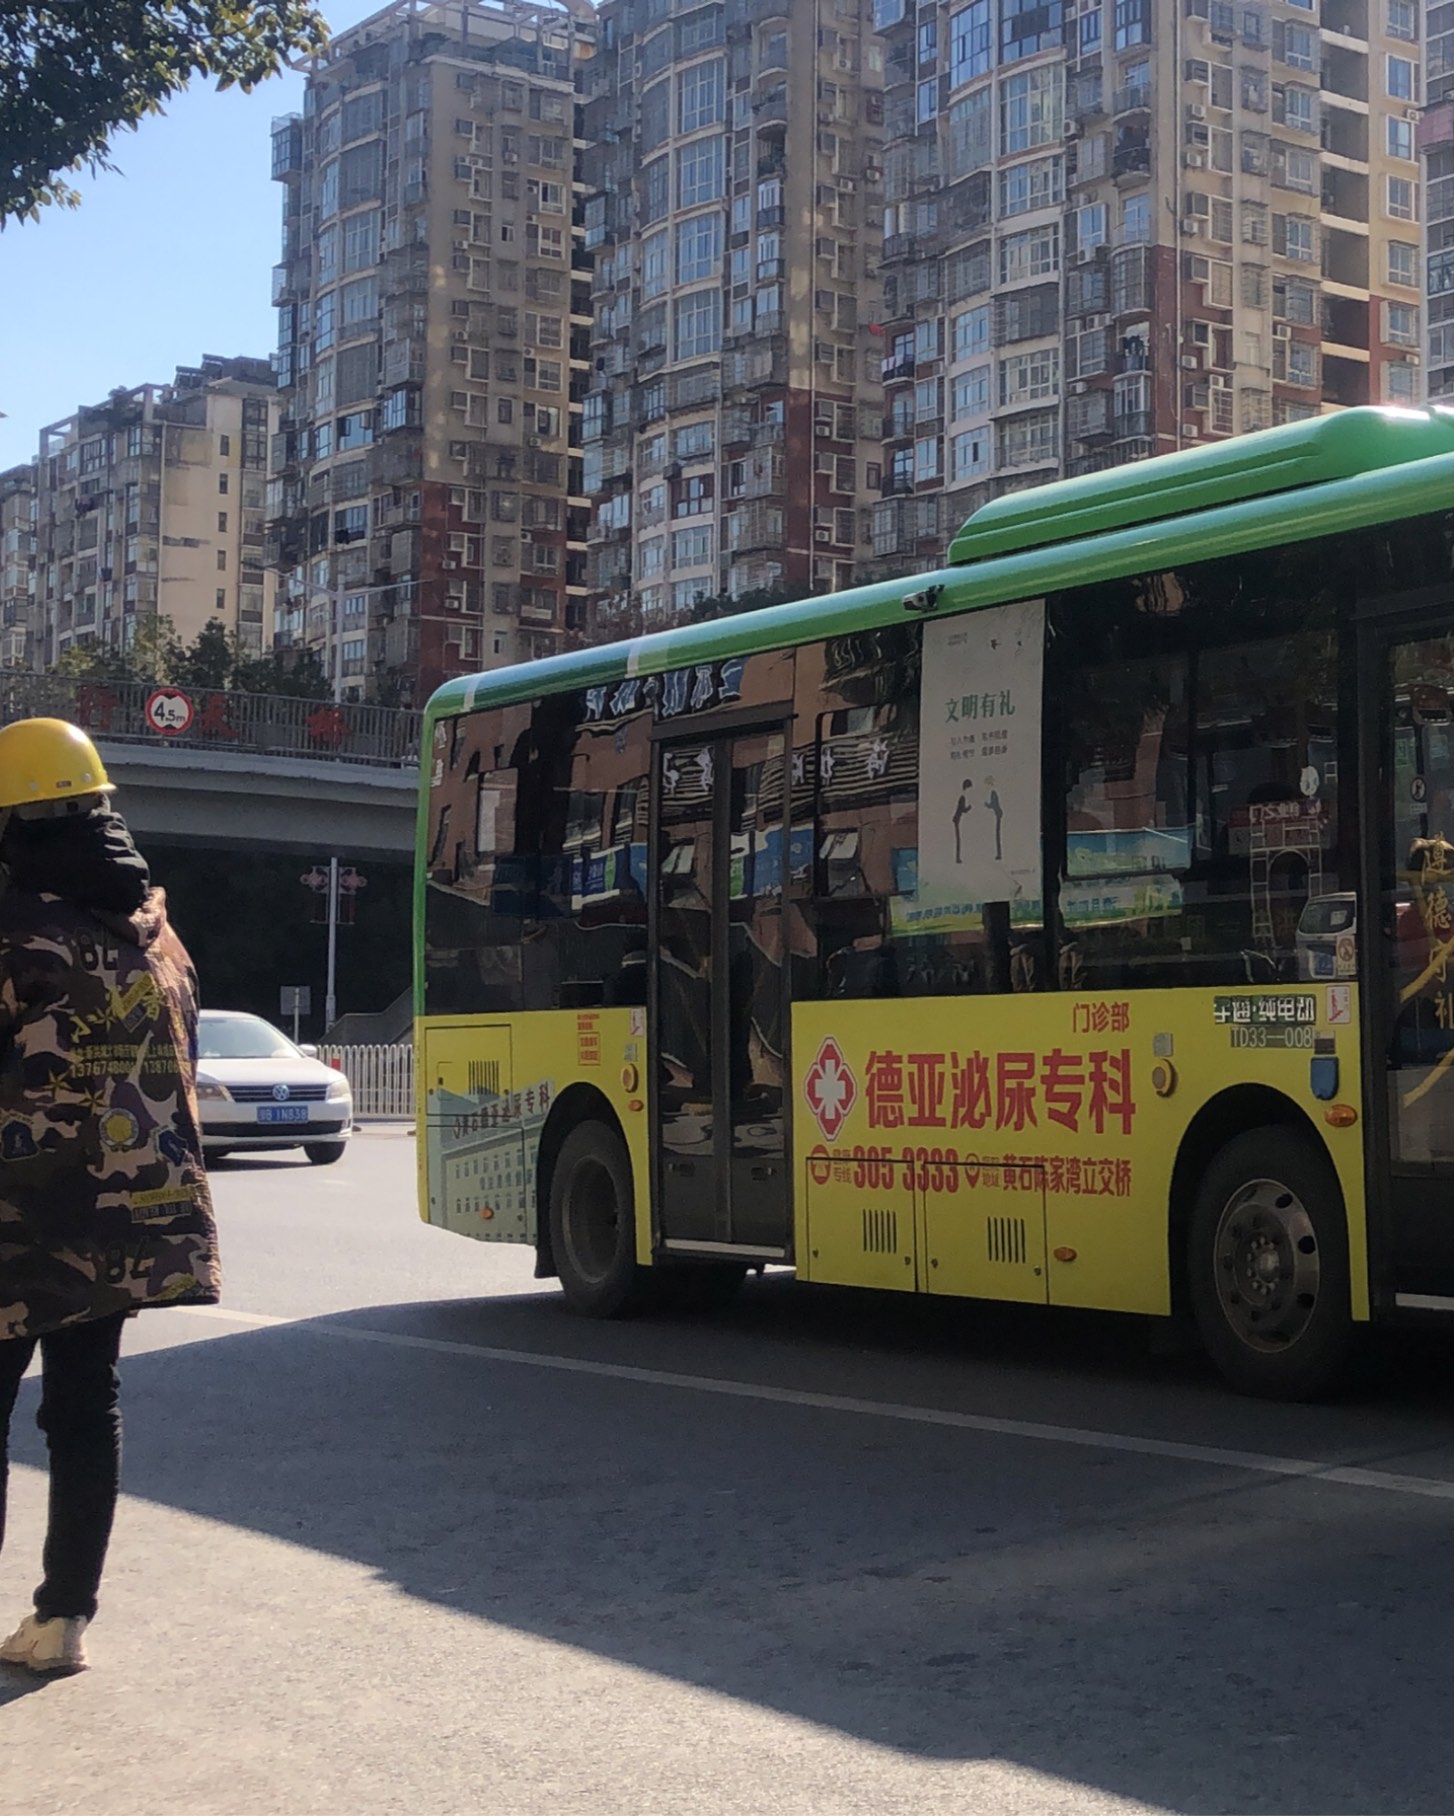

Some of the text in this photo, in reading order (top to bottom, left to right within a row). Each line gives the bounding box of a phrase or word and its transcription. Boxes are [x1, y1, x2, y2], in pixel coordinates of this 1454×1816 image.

[945, 689, 1016, 723] 文明有礼
[1072, 1002, 1131, 1034] 门诊部
[864, 1047, 1137, 1136] 德亚泌尿专科
[853, 1146, 960, 1195] 305 3333
[1002, 1153, 1133, 1197] 黄石陈家湾立交桥
